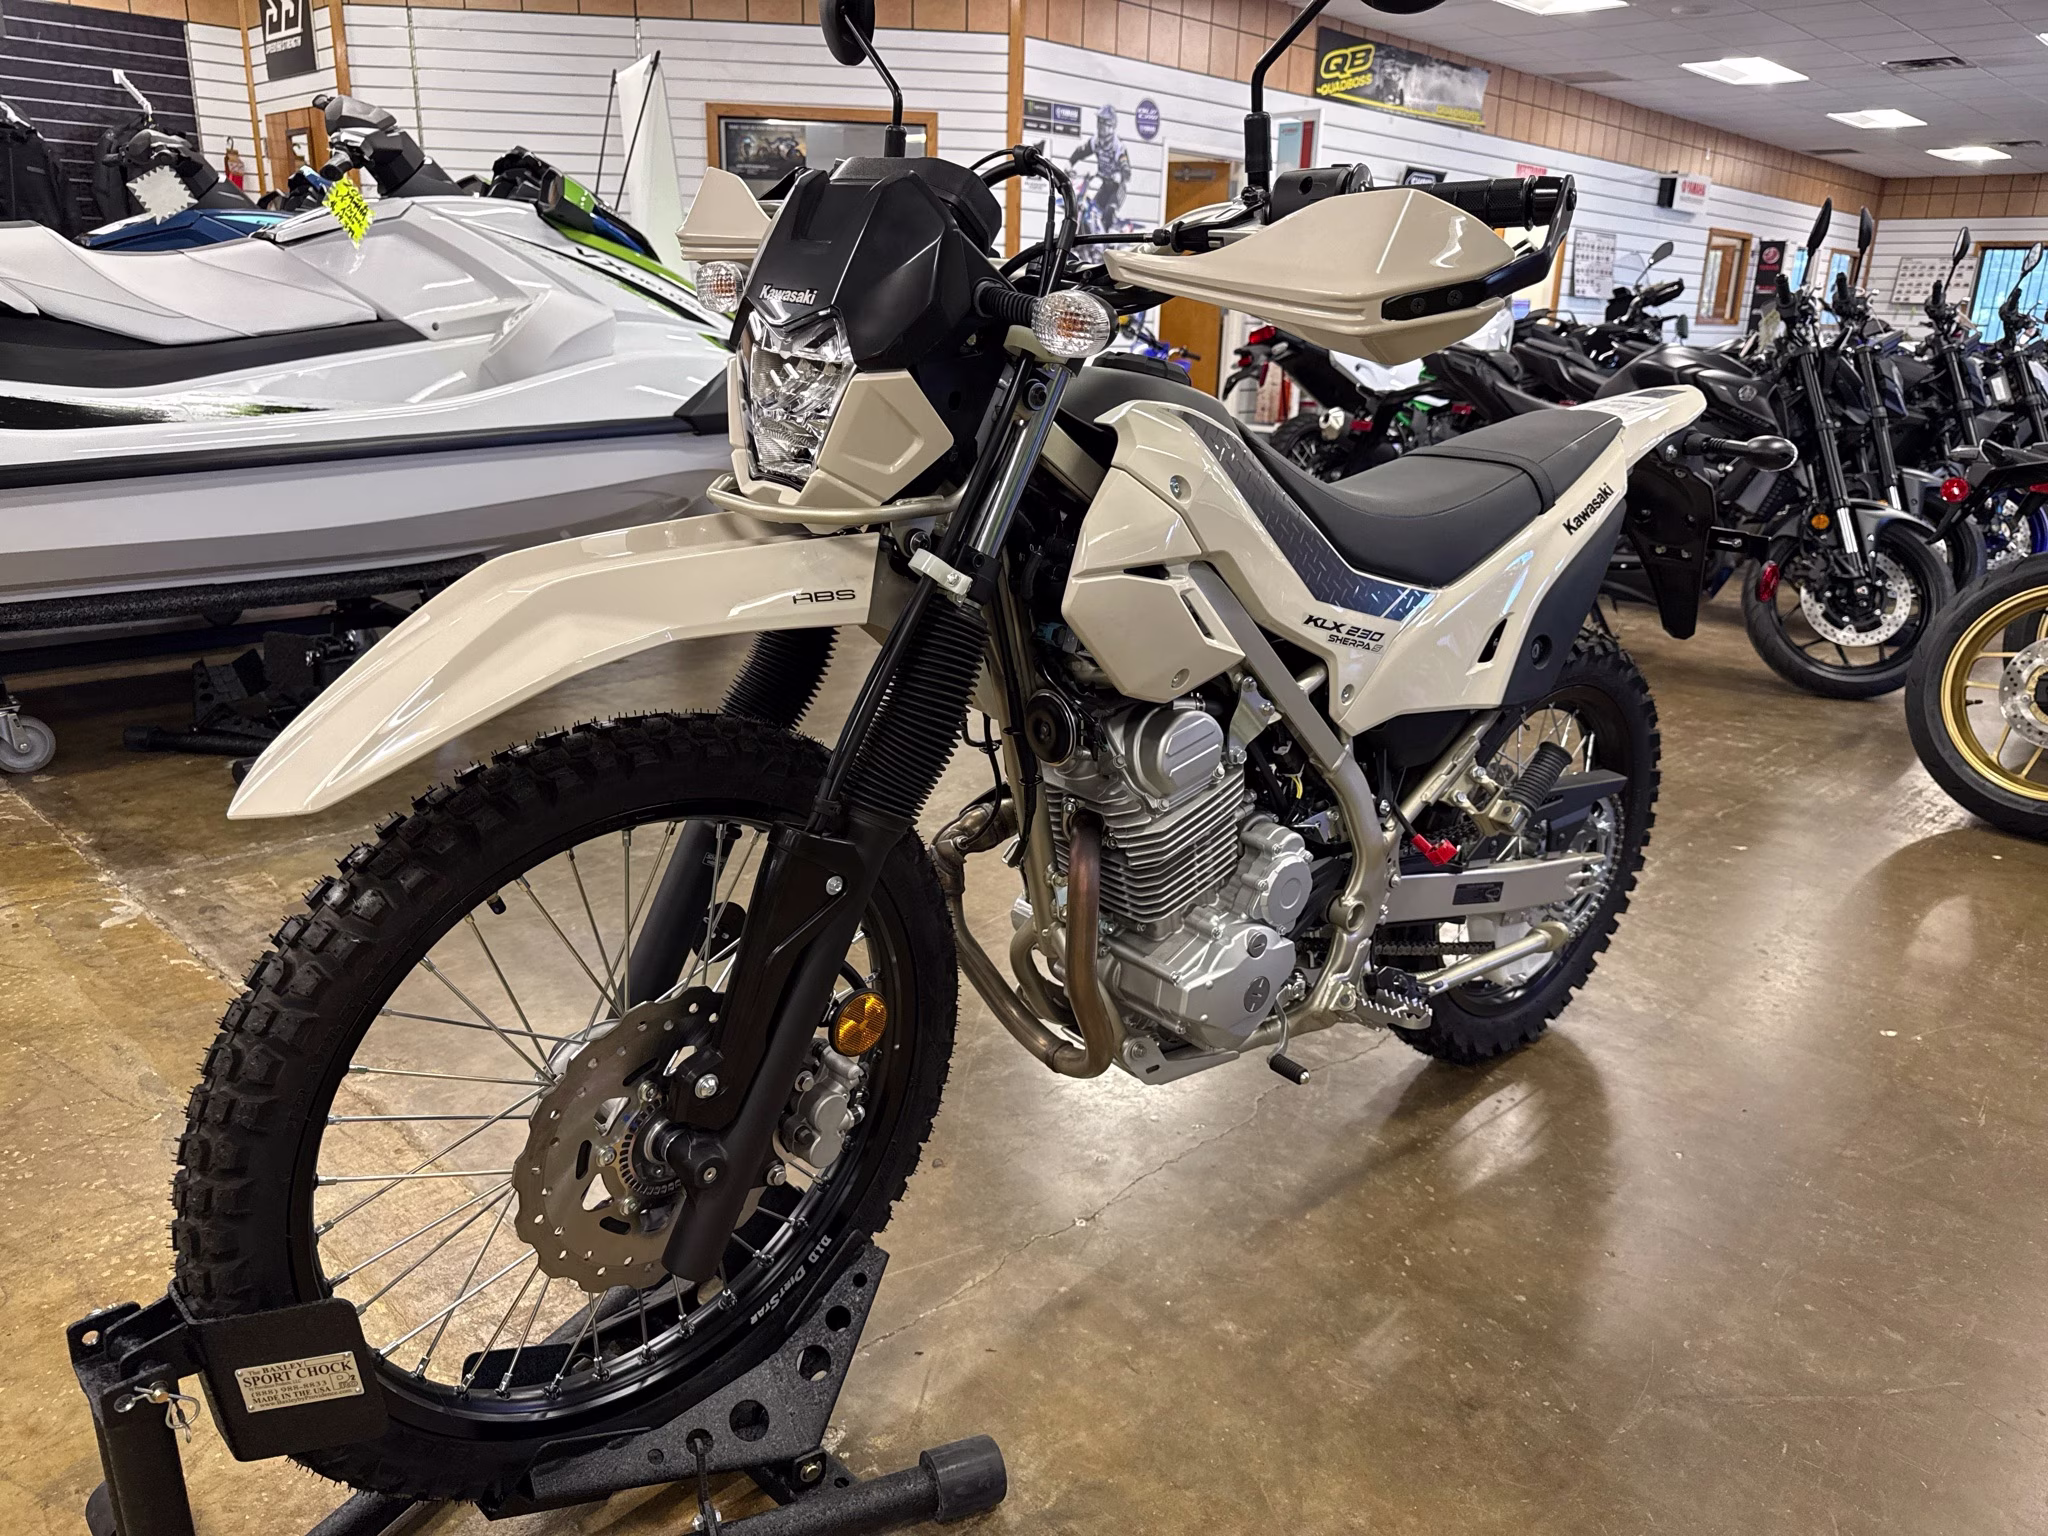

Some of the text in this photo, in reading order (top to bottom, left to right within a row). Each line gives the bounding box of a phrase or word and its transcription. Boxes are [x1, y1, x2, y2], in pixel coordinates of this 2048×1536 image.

[1321, 44, 1375, 79] QB
[575, 247, 627, 273] VX
[759, 284, 818, 305] Kawasaki
[1562, 482, 1614, 536] Kawasaki
[792, 589, 856, 604] ABS
[1303, 614, 1385, 642] KLX 230
[1328, 634, 1371, 651] SHERPA
[243, 1360, 353, 1388] SPORT CHOCK
[262, 1361, 304, 1374] BAXLEY
[252, 1386, 331, 1404] MADE IN THE USA
